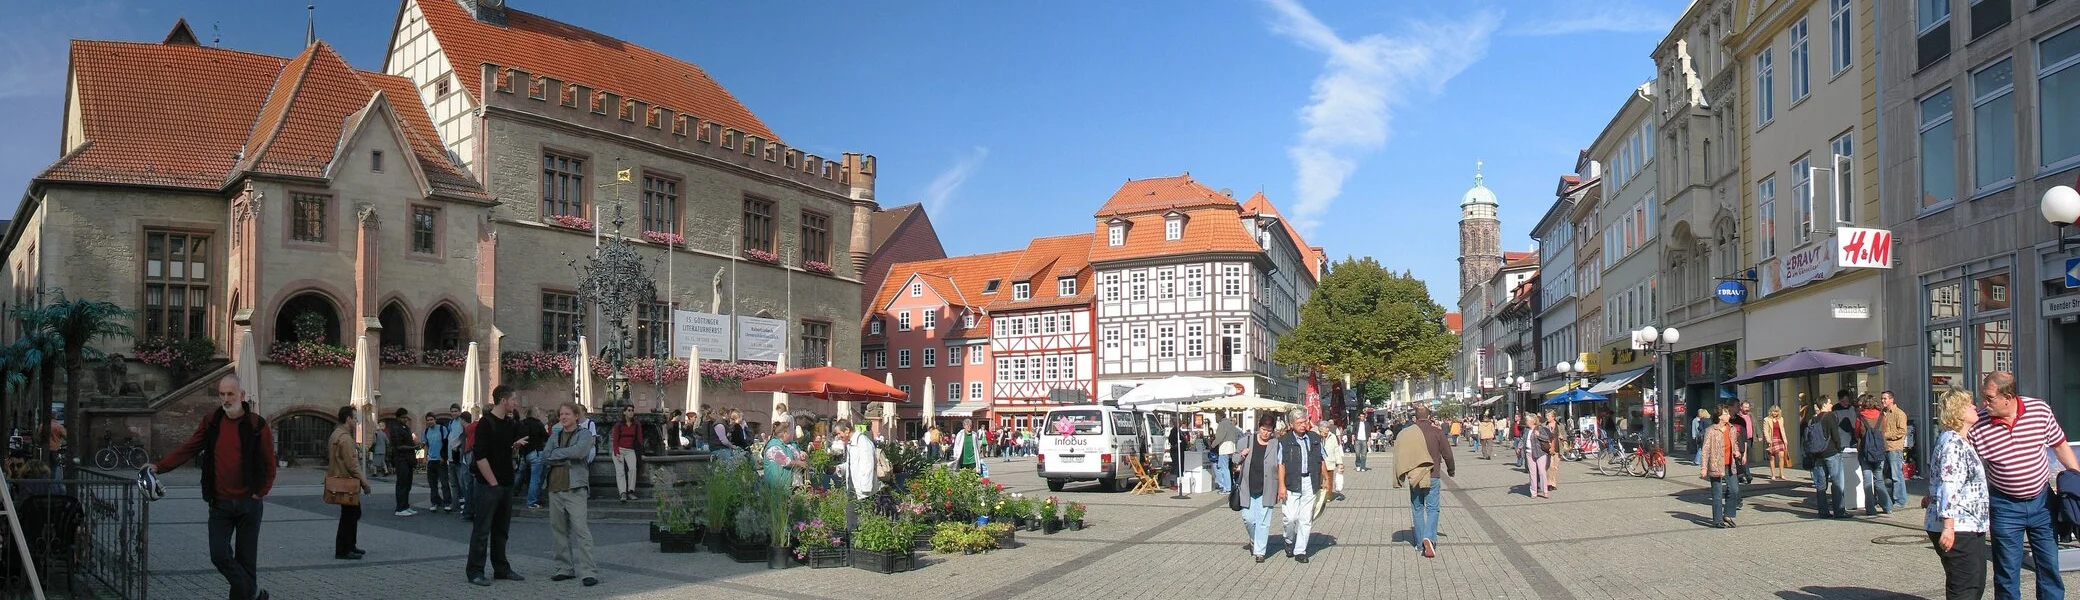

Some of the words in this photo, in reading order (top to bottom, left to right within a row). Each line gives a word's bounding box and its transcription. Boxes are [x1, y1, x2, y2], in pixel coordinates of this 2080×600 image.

[1843, 231, 1891, 267] H&M
[1791, 246, 1822, 270] BRAUT
[2049, 301, 2071, 311] Weender
[682, 325, 723, 335] LITERATURHERBST
